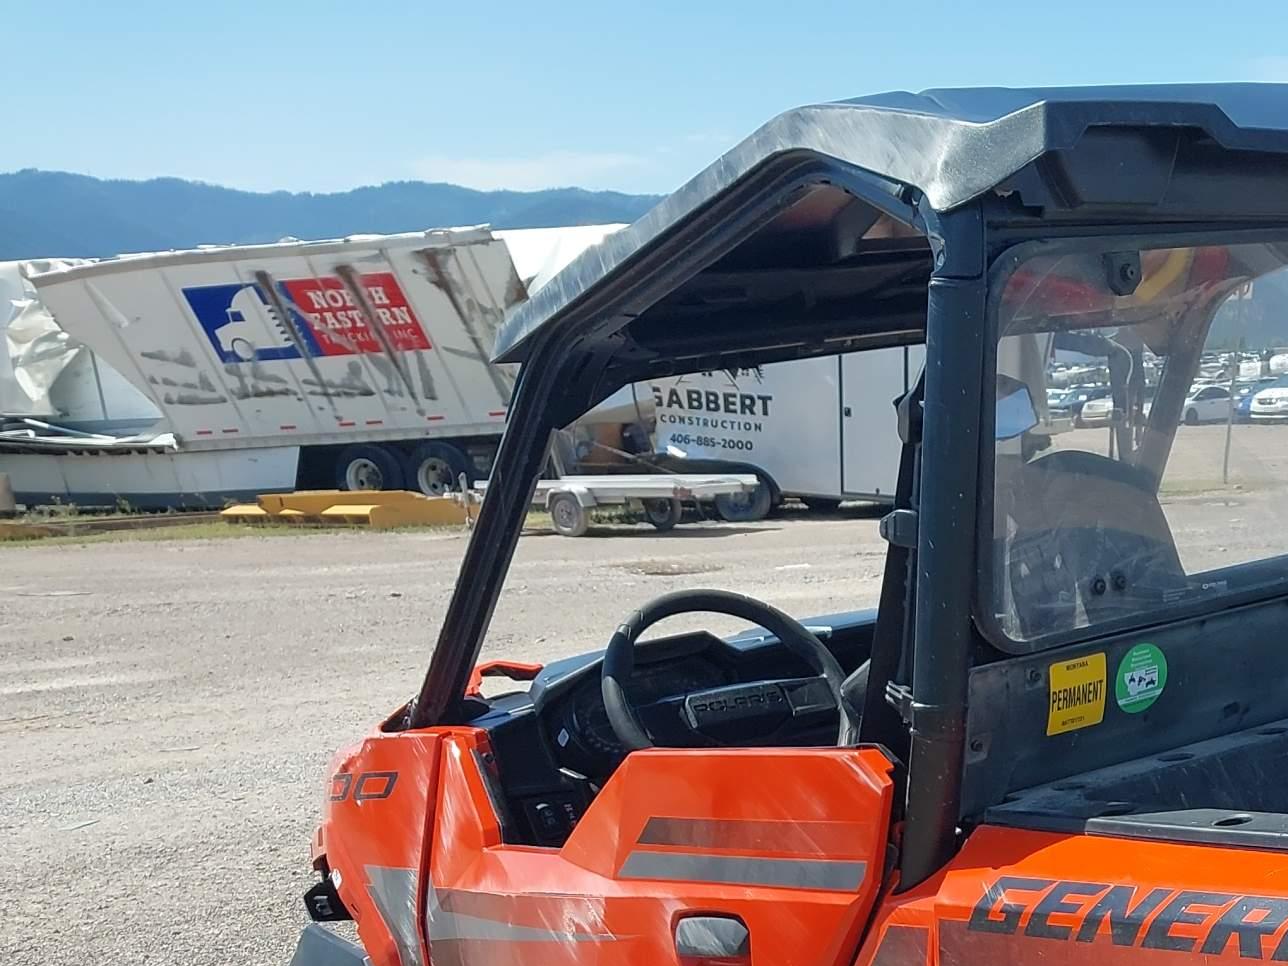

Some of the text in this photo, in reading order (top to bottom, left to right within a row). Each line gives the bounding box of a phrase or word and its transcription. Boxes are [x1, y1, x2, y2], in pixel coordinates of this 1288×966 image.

[309, 306, 413, 331] EASTRN
[659, 413, 763, 432] CONSTRUCTION
[670, 433, 753, 451] 406-885-2000
[1051, 680, 1104, 713] PERMANENT
